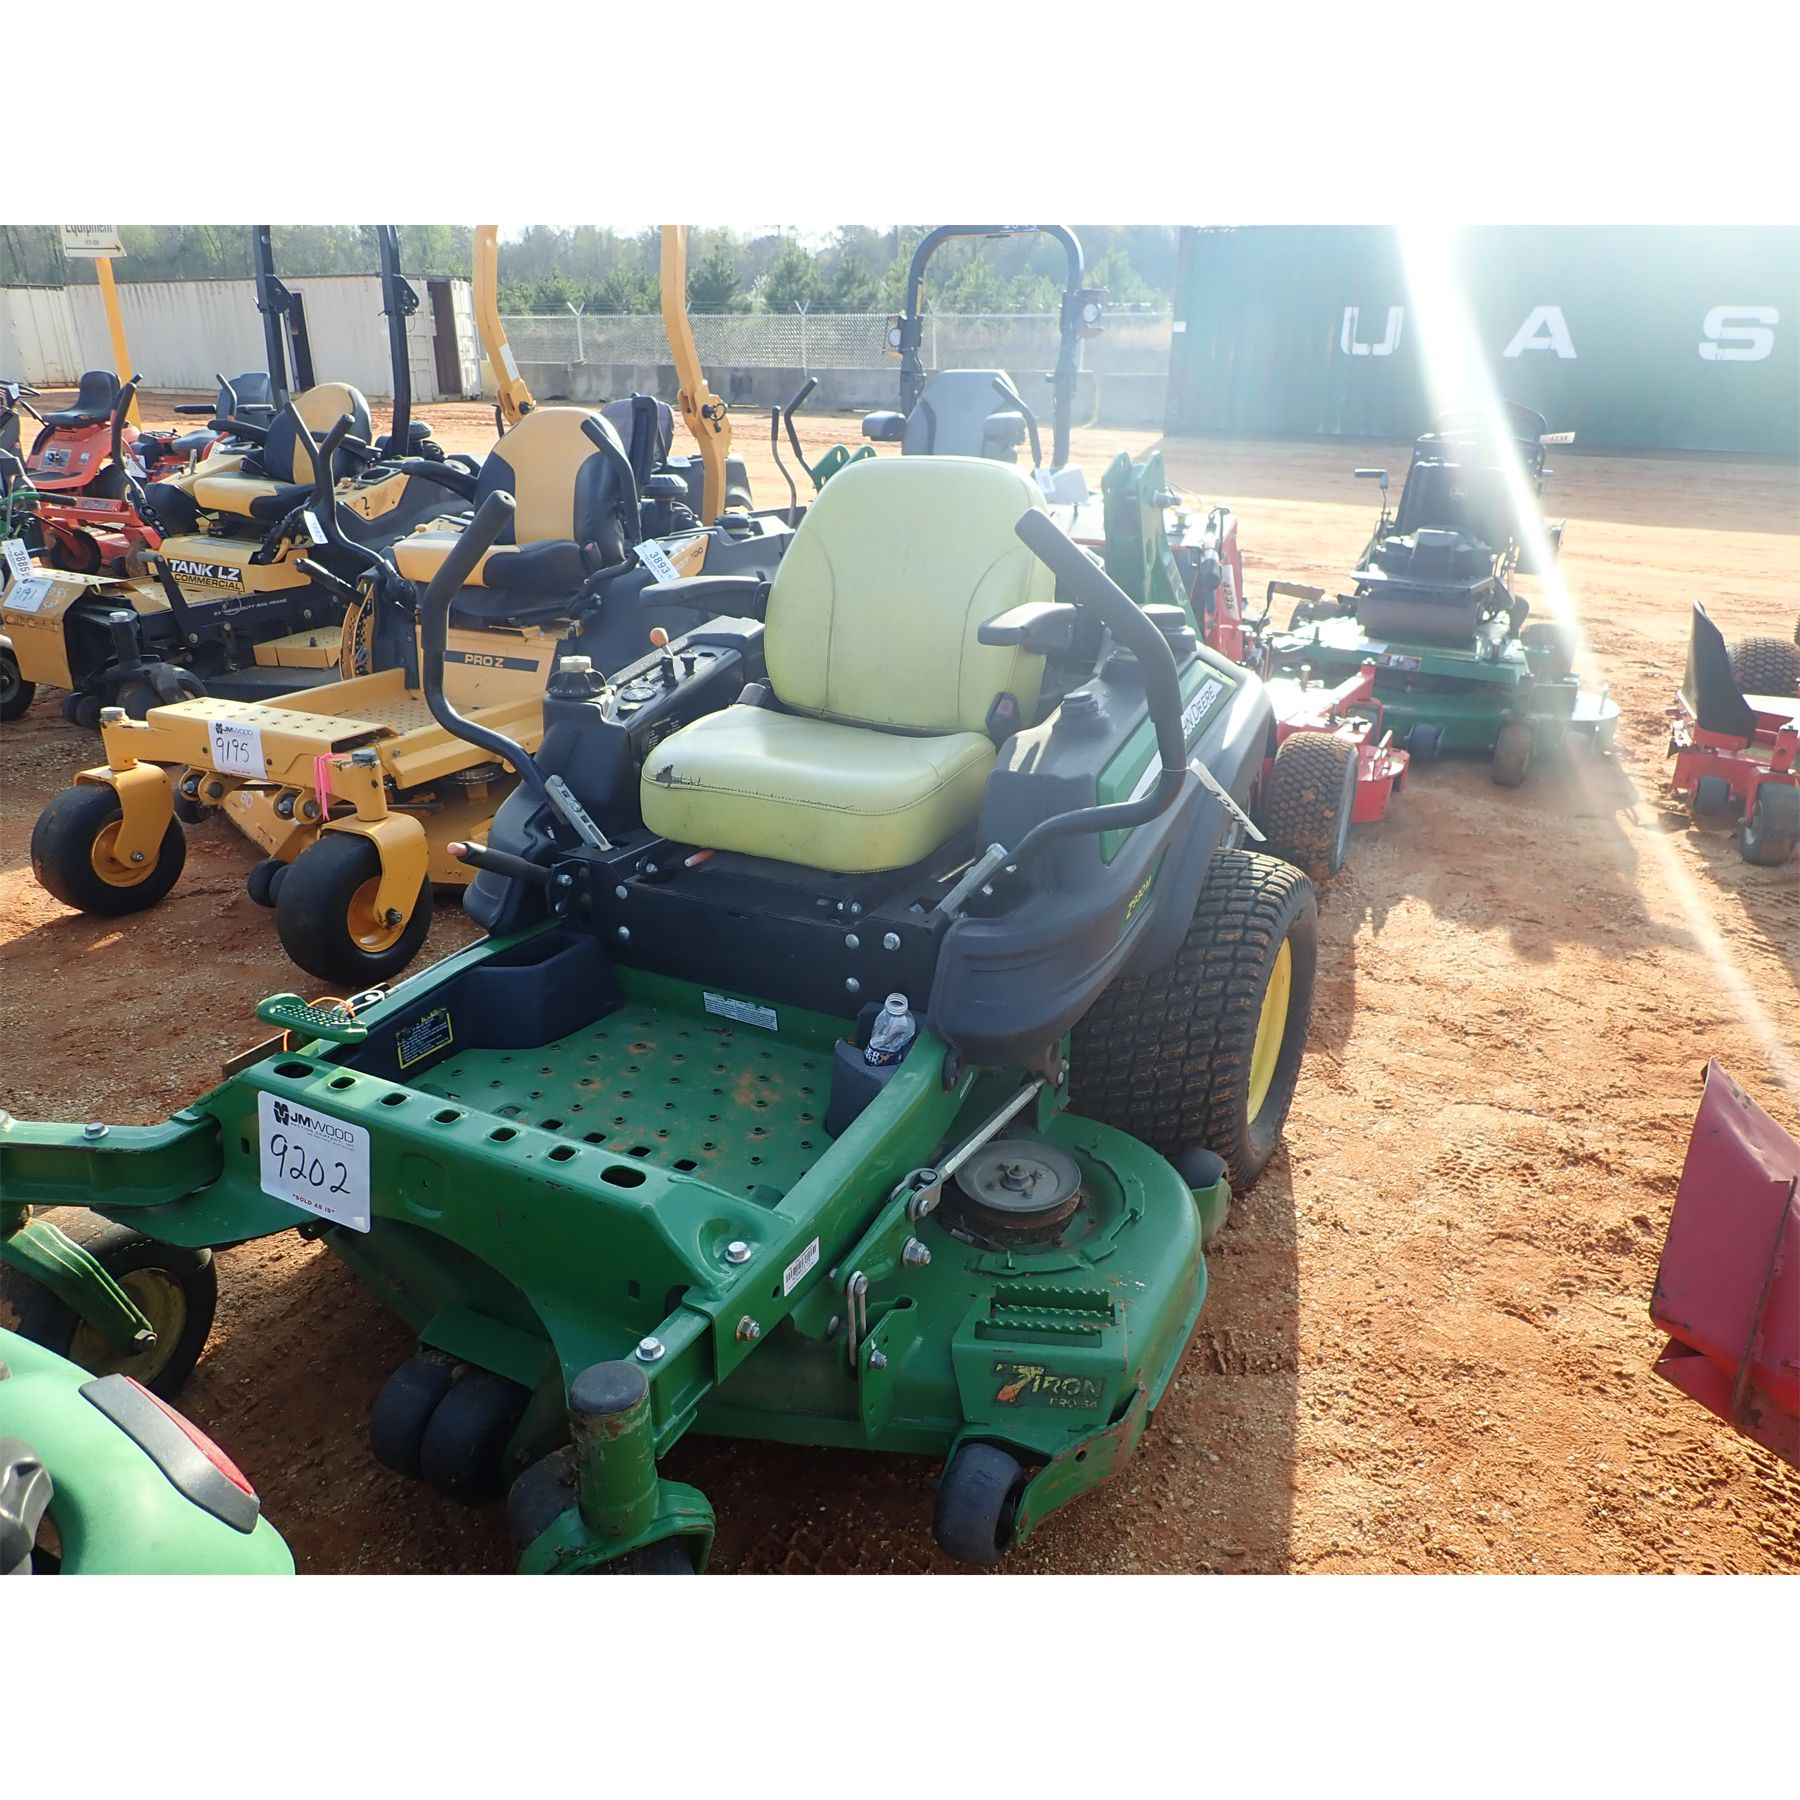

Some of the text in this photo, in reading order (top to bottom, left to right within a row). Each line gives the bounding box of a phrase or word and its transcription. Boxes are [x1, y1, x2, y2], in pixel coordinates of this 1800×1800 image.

[14, 550, 31, 574] 3885
[169, 559, 240, 581] TANK LZ
[649, 551, 672, 575] 3893
[174, 573, 241, 590] COMMERCIAL
[464, 653, 504, 668] PRO Z
[215, 737, 250, 763] 9195
[270, 1133, 352, 1195] 9202
[313, 1202, 323, 1210] AS
